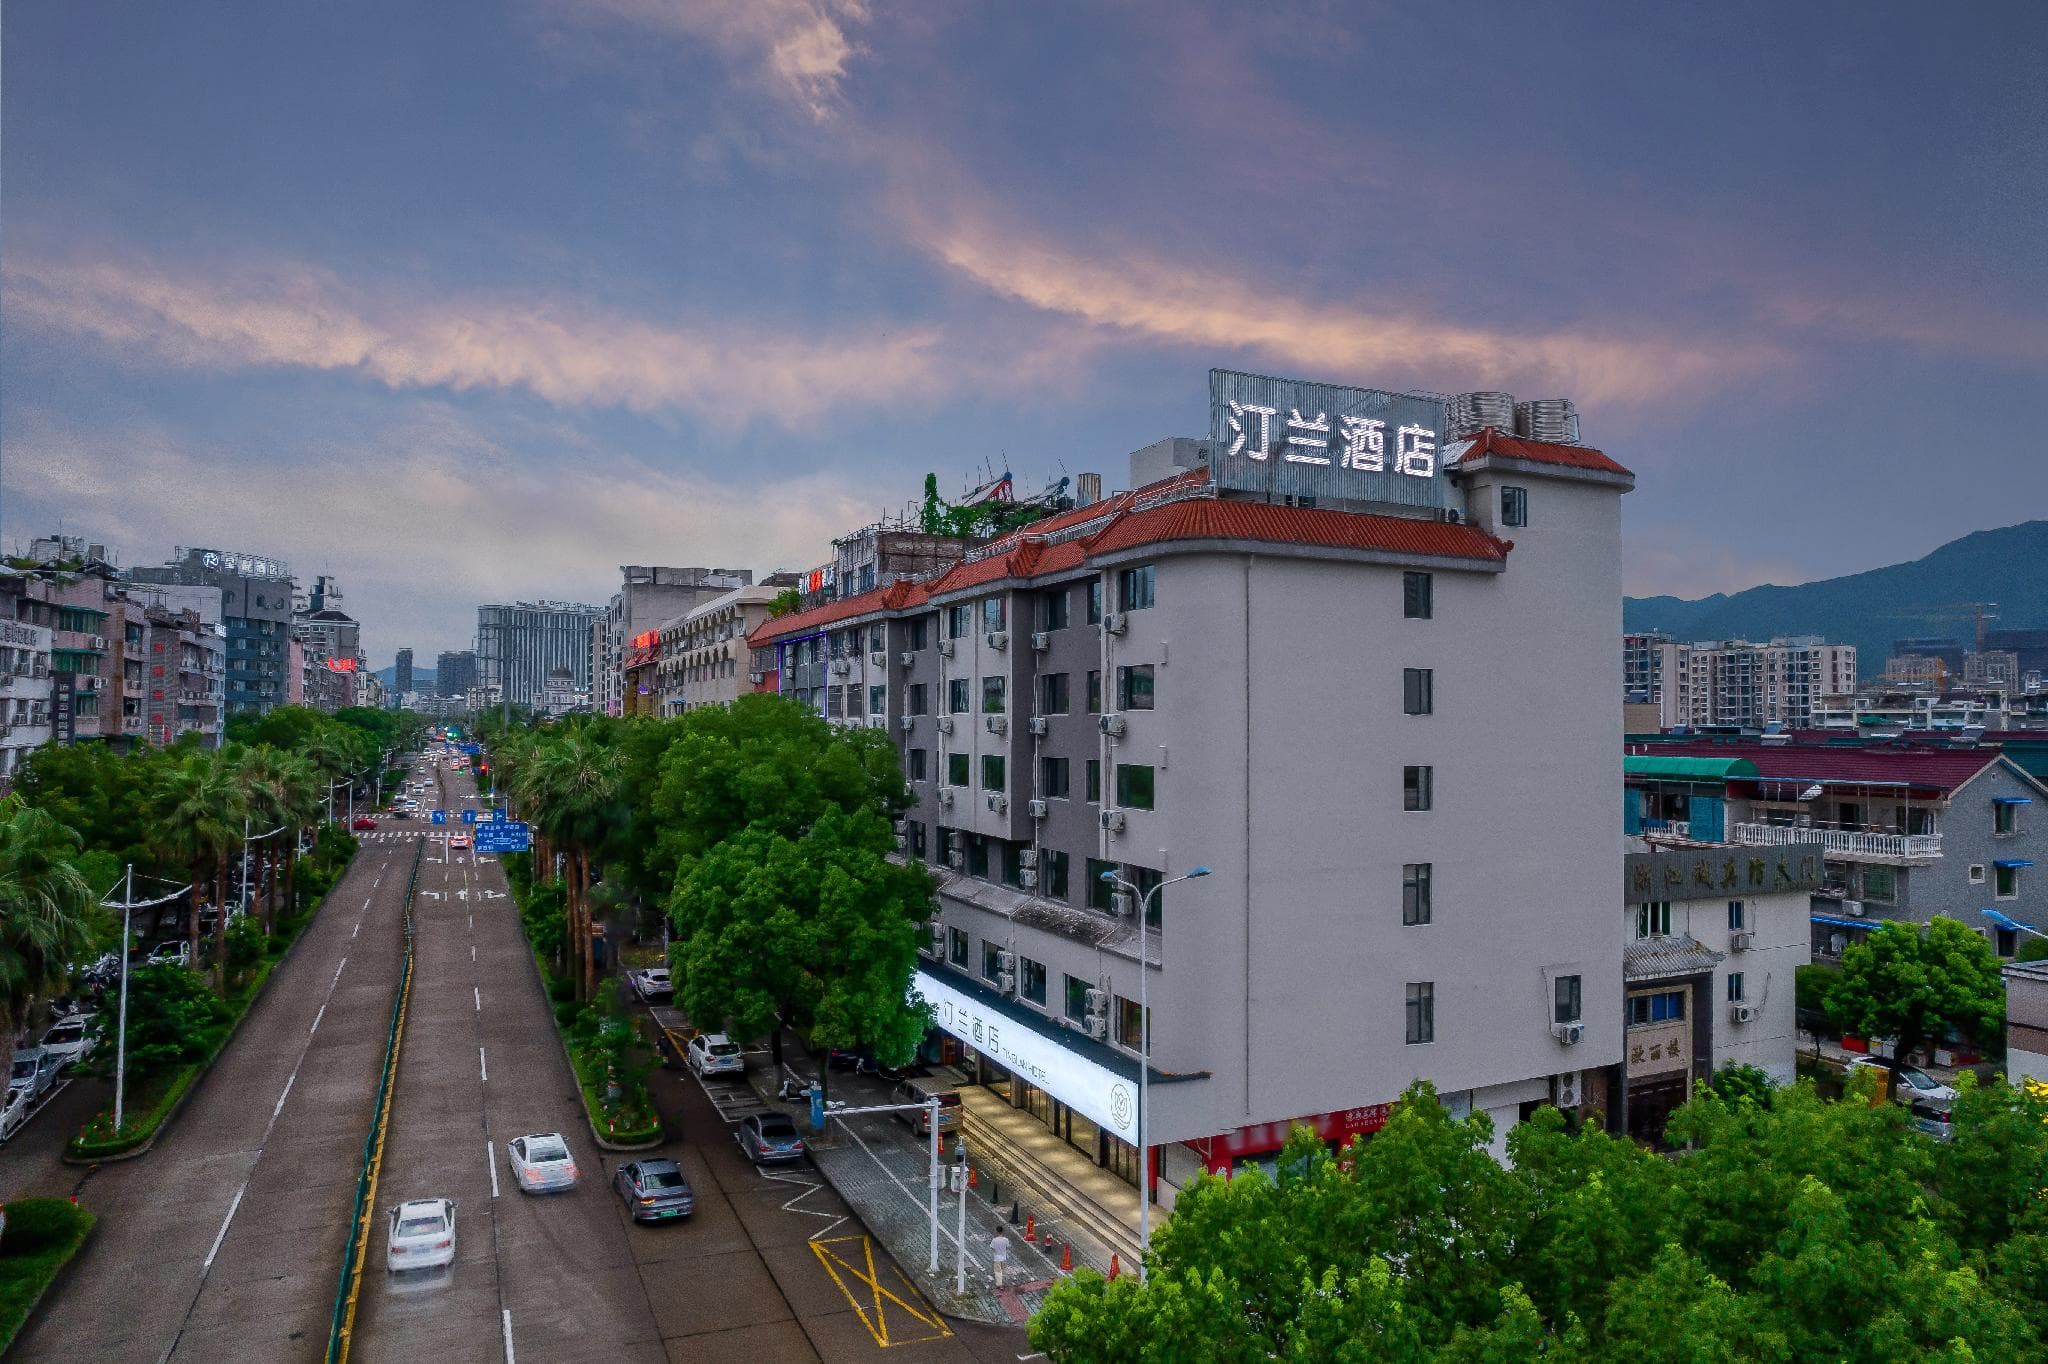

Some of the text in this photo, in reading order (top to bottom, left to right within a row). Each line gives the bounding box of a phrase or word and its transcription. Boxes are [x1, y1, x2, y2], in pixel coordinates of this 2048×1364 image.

[1228, 400, 1435, 478] 汀兰酒店
[943, 999, 999, 1053] 汀兰酒店
